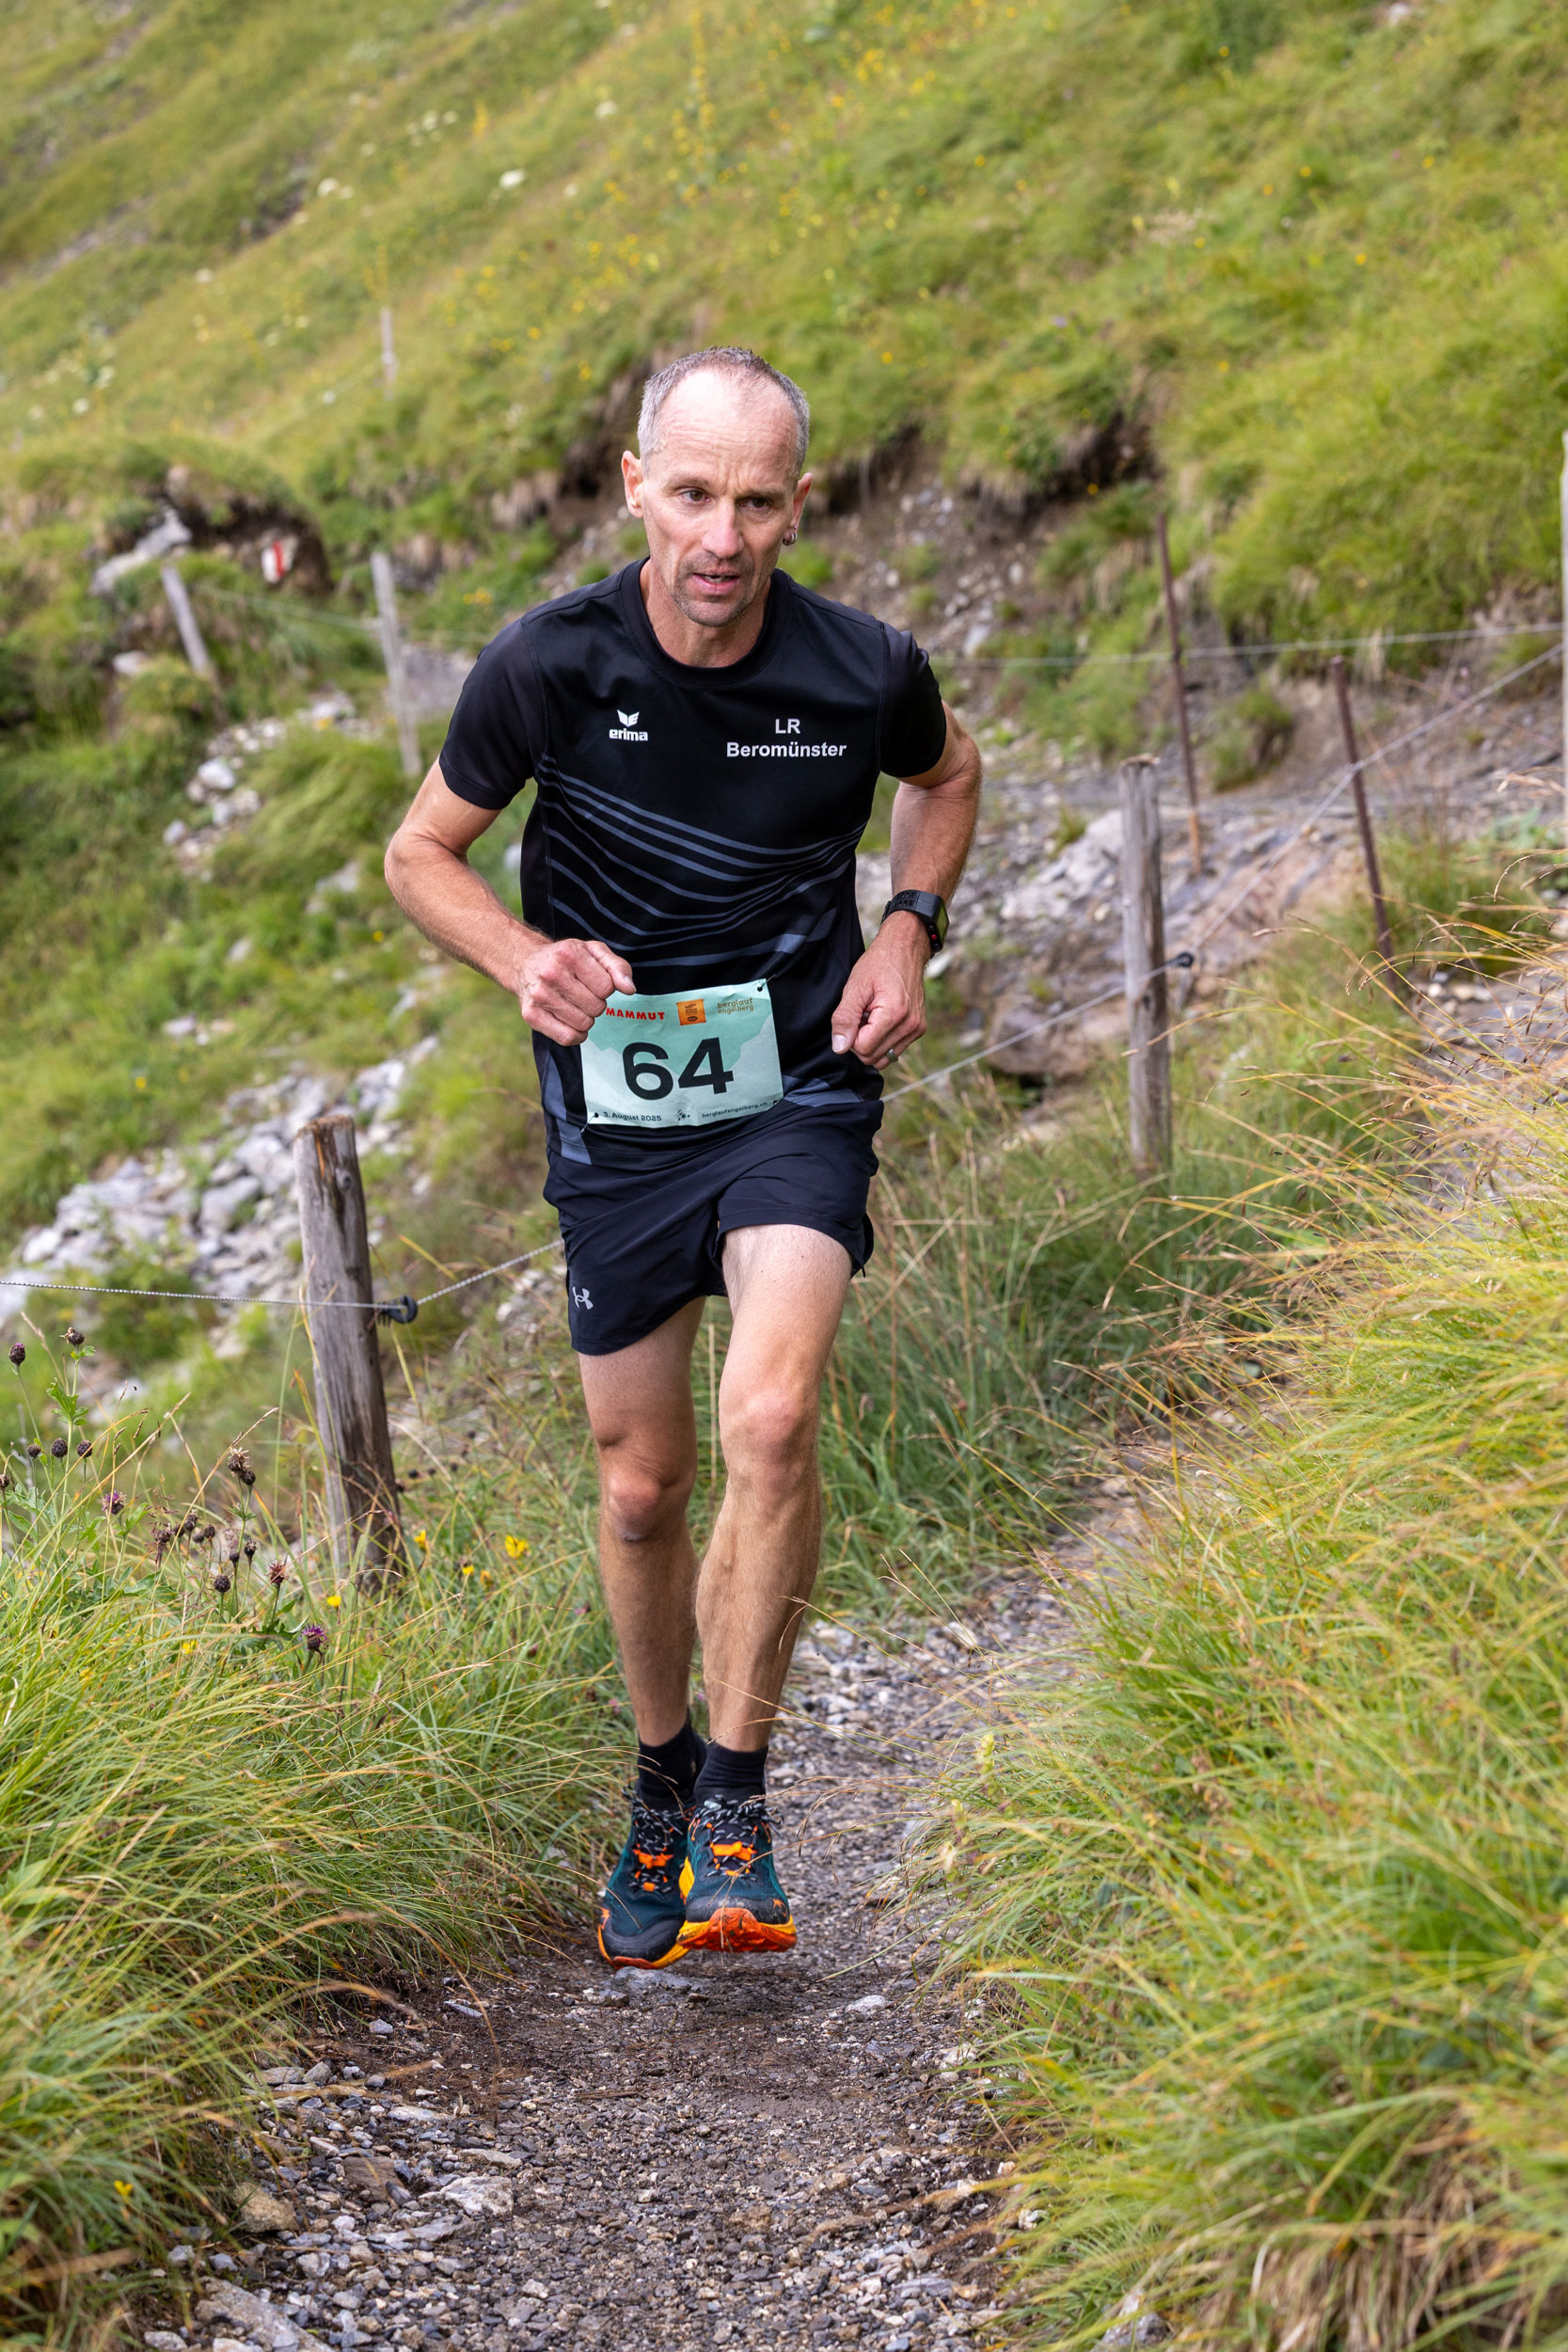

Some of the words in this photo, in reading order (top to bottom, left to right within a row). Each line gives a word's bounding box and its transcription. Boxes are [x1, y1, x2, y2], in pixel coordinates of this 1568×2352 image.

[775, 719, 800, 734] LR
[609, 728, 649, 741] erima
[726, 741, 847, 757] Beromünster
[717, 997, 753, 1009] berglauf
[718, 1005, 754, 1014] engelberg
[606, 1008, 665, 1020] MAMMUT
[622, 1037, 734, 1101] 64
[611, 1112, 640, 1121] August
[702, 1101, 768, 1119] berglaufengelberg.ch
